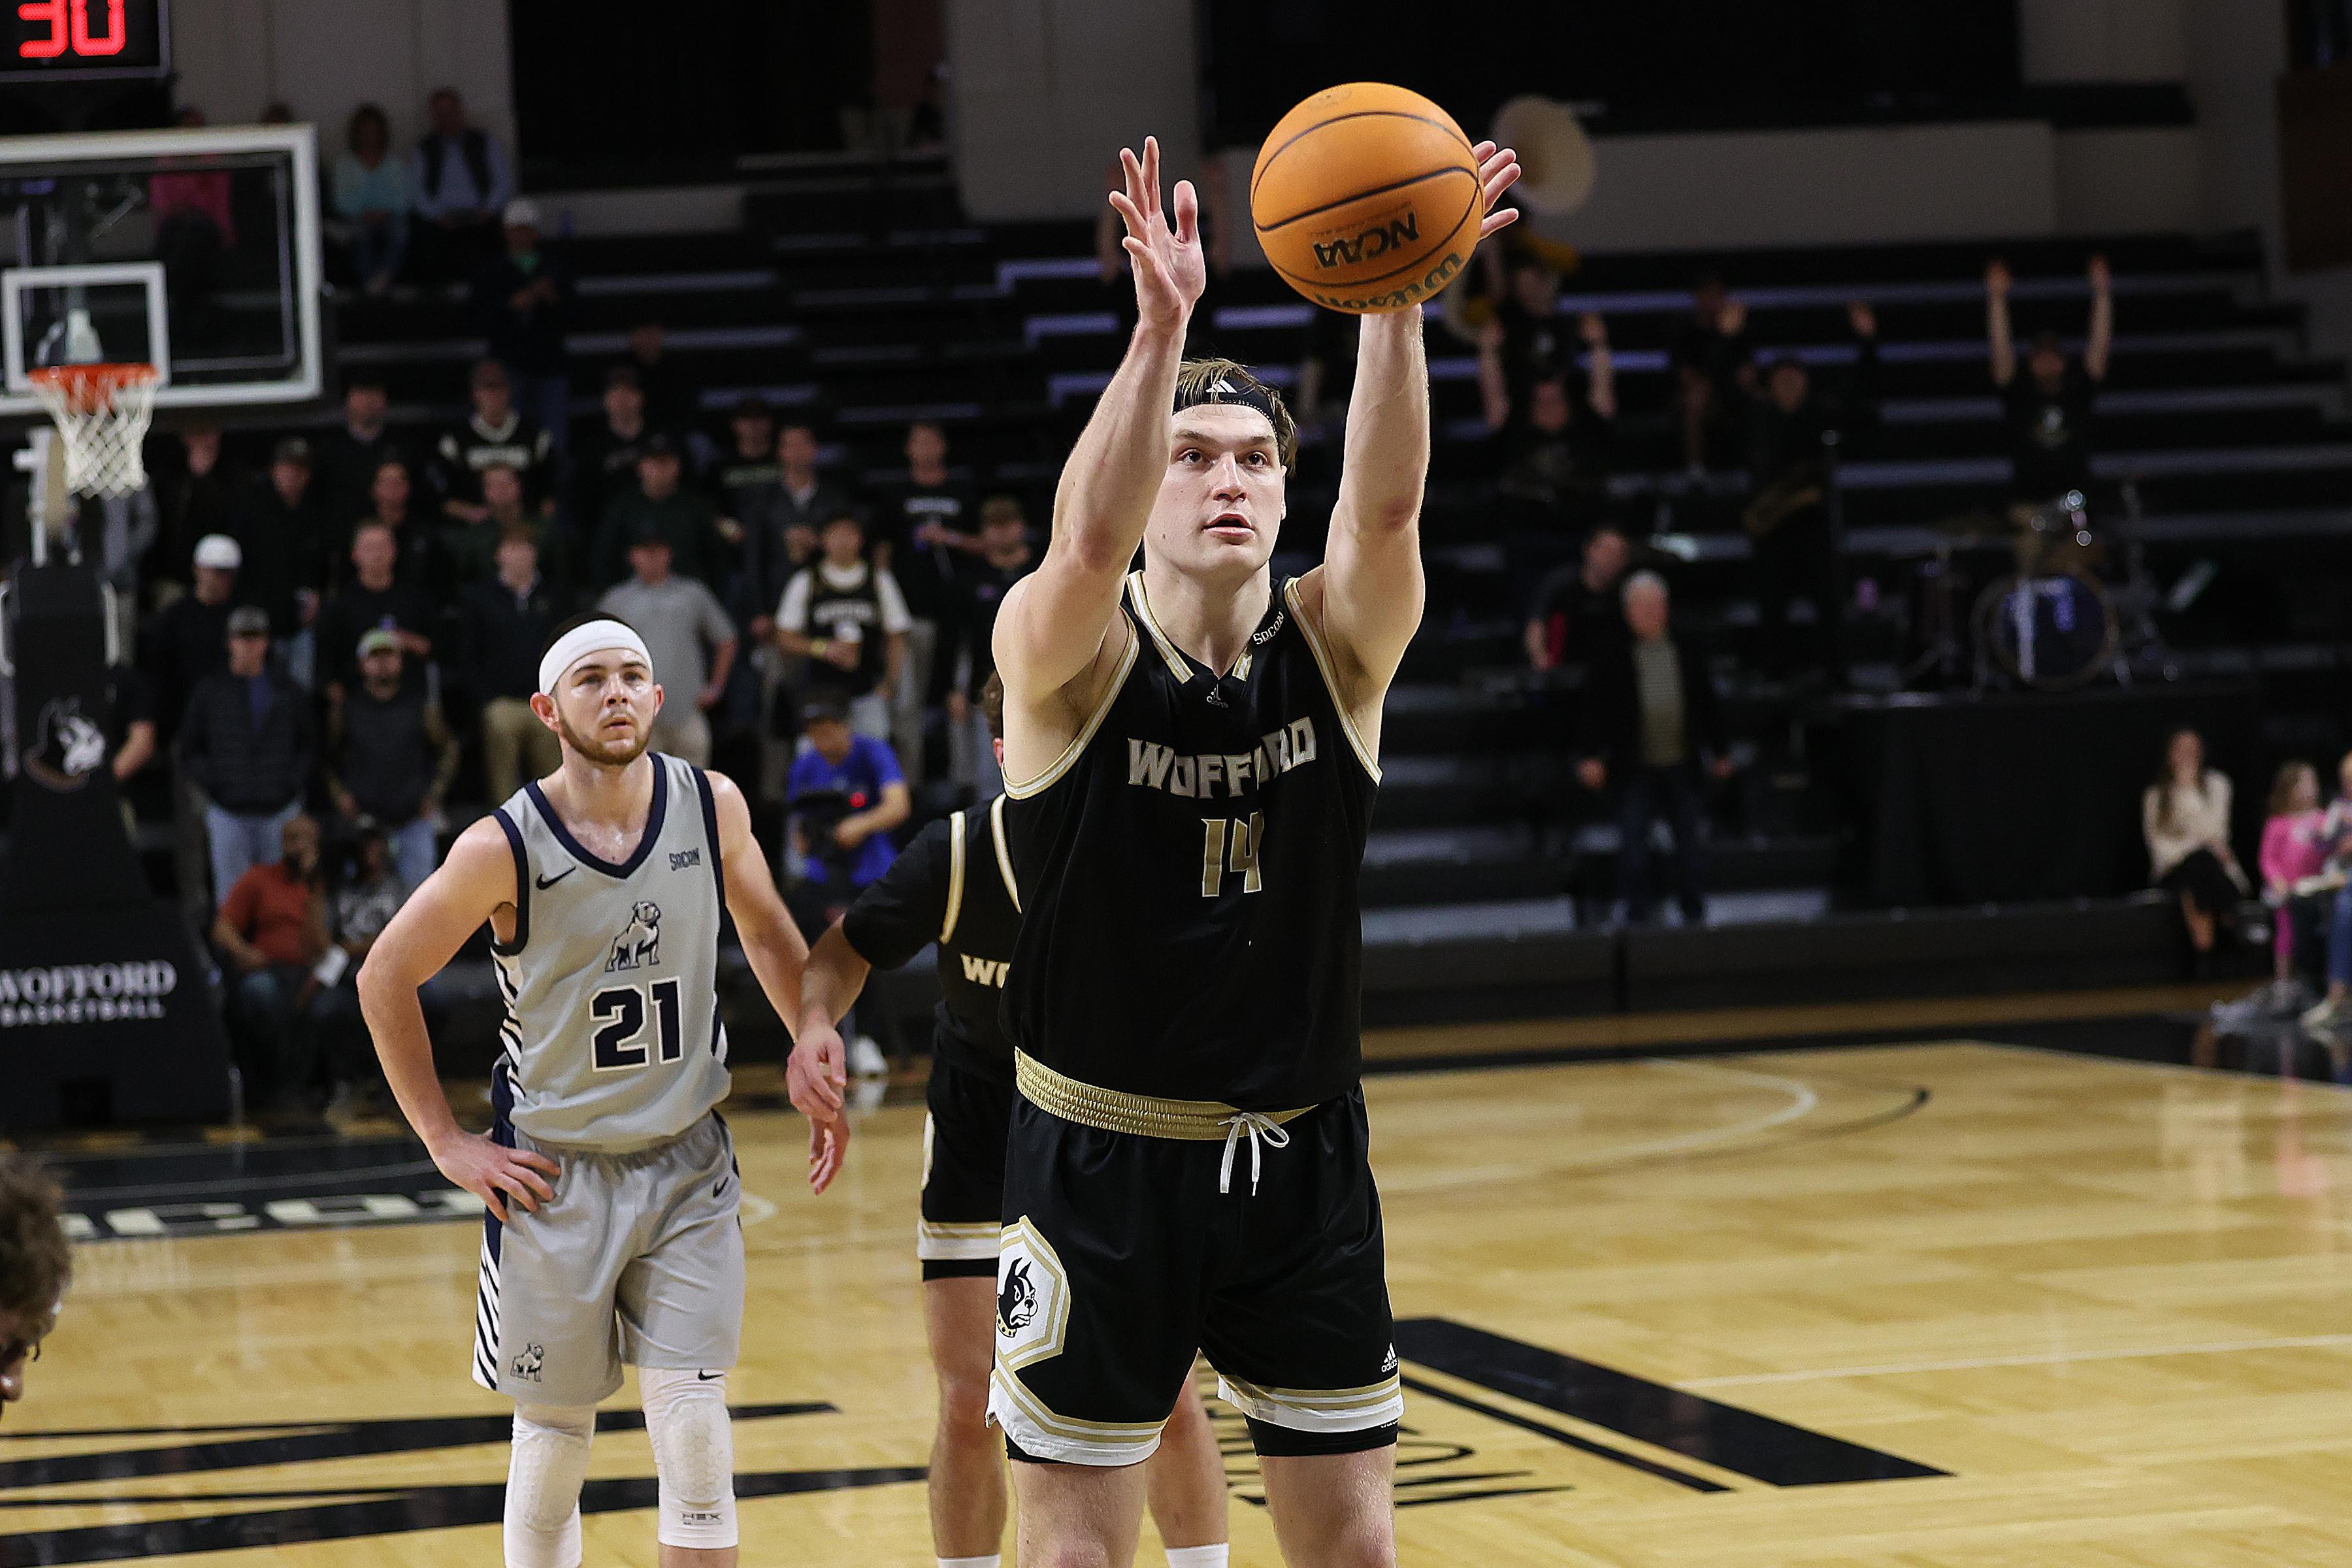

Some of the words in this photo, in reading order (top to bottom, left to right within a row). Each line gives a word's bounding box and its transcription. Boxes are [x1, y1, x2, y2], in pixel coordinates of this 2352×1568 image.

[16, 0, 125, 57] 30
[1313, 210, 1420, 269] NCAA
[1252, 611, 1284, 645] SOCON
[1201, 809, 1264, 898] 14
[590, 977, 683, 1071] 21
